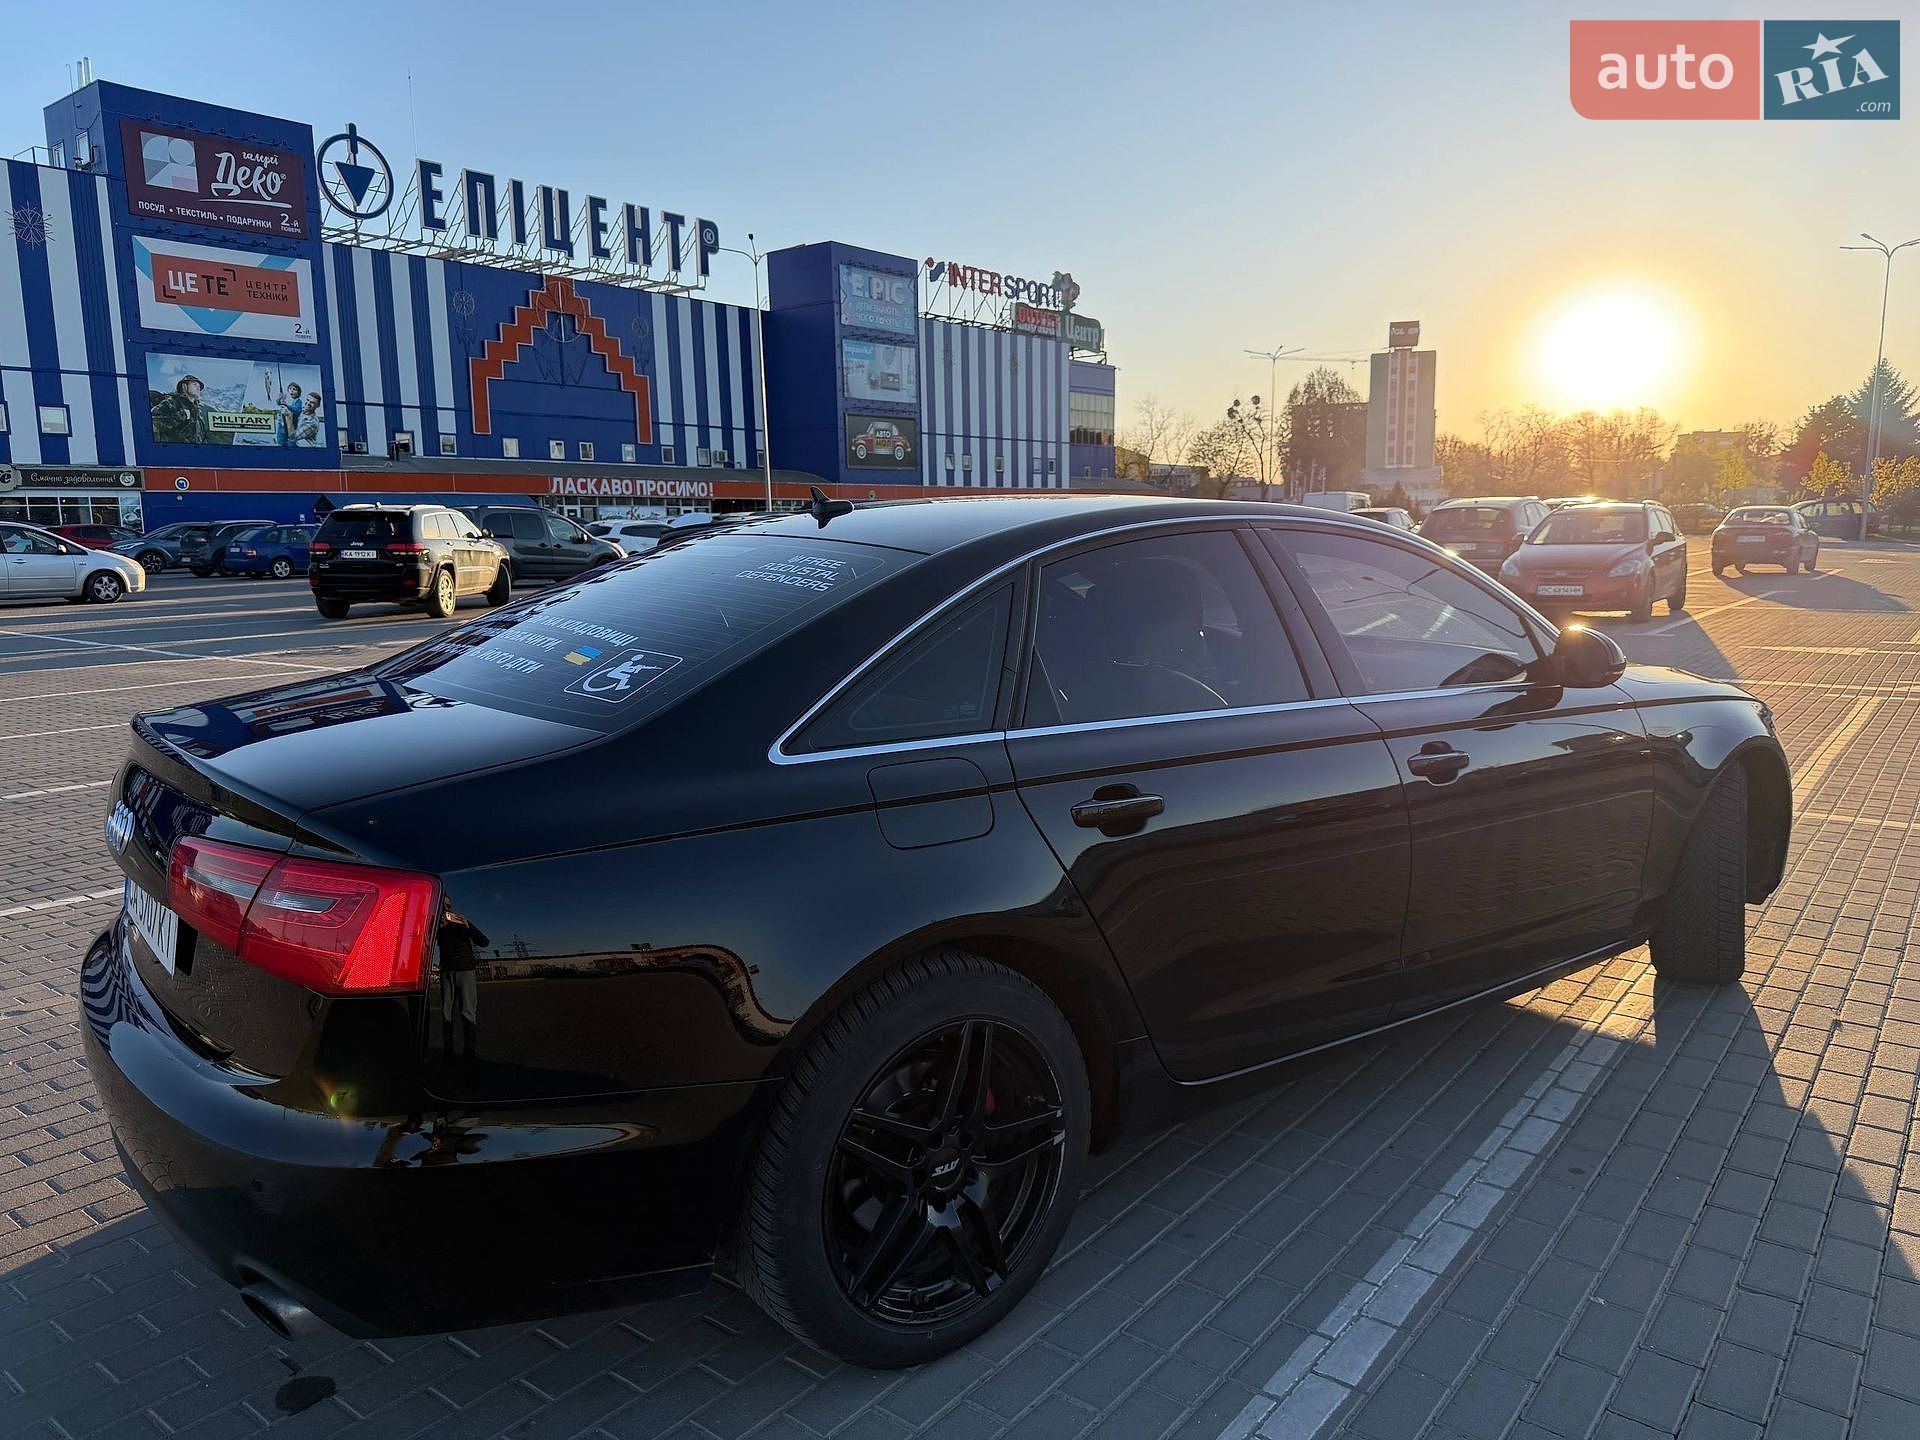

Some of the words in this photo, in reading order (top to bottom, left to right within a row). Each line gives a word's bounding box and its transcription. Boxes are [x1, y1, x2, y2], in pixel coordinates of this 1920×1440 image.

[211, 152, 283, 200] Деко
[138, 201, 165, 214] ПОСУД
[176, 207, 218, 221] ТЕКСТИЛЬ
[227, 215, 272, 229] ПОДАРУНКИ
[415, 157, 720, 277] ЕПІЦЕНТР
[245, 280, 287, 291] ЦЕНТР
[247, 290, 288, 302] ТЕХНІКИ
[212, 415, 270, 424] MILITARY
[551, 477, 632, 495] ЛАСКАВО
[636, 479, 714, 497] ПРОСИМО!
[735, 570, 834, 592] DEFENDERS
